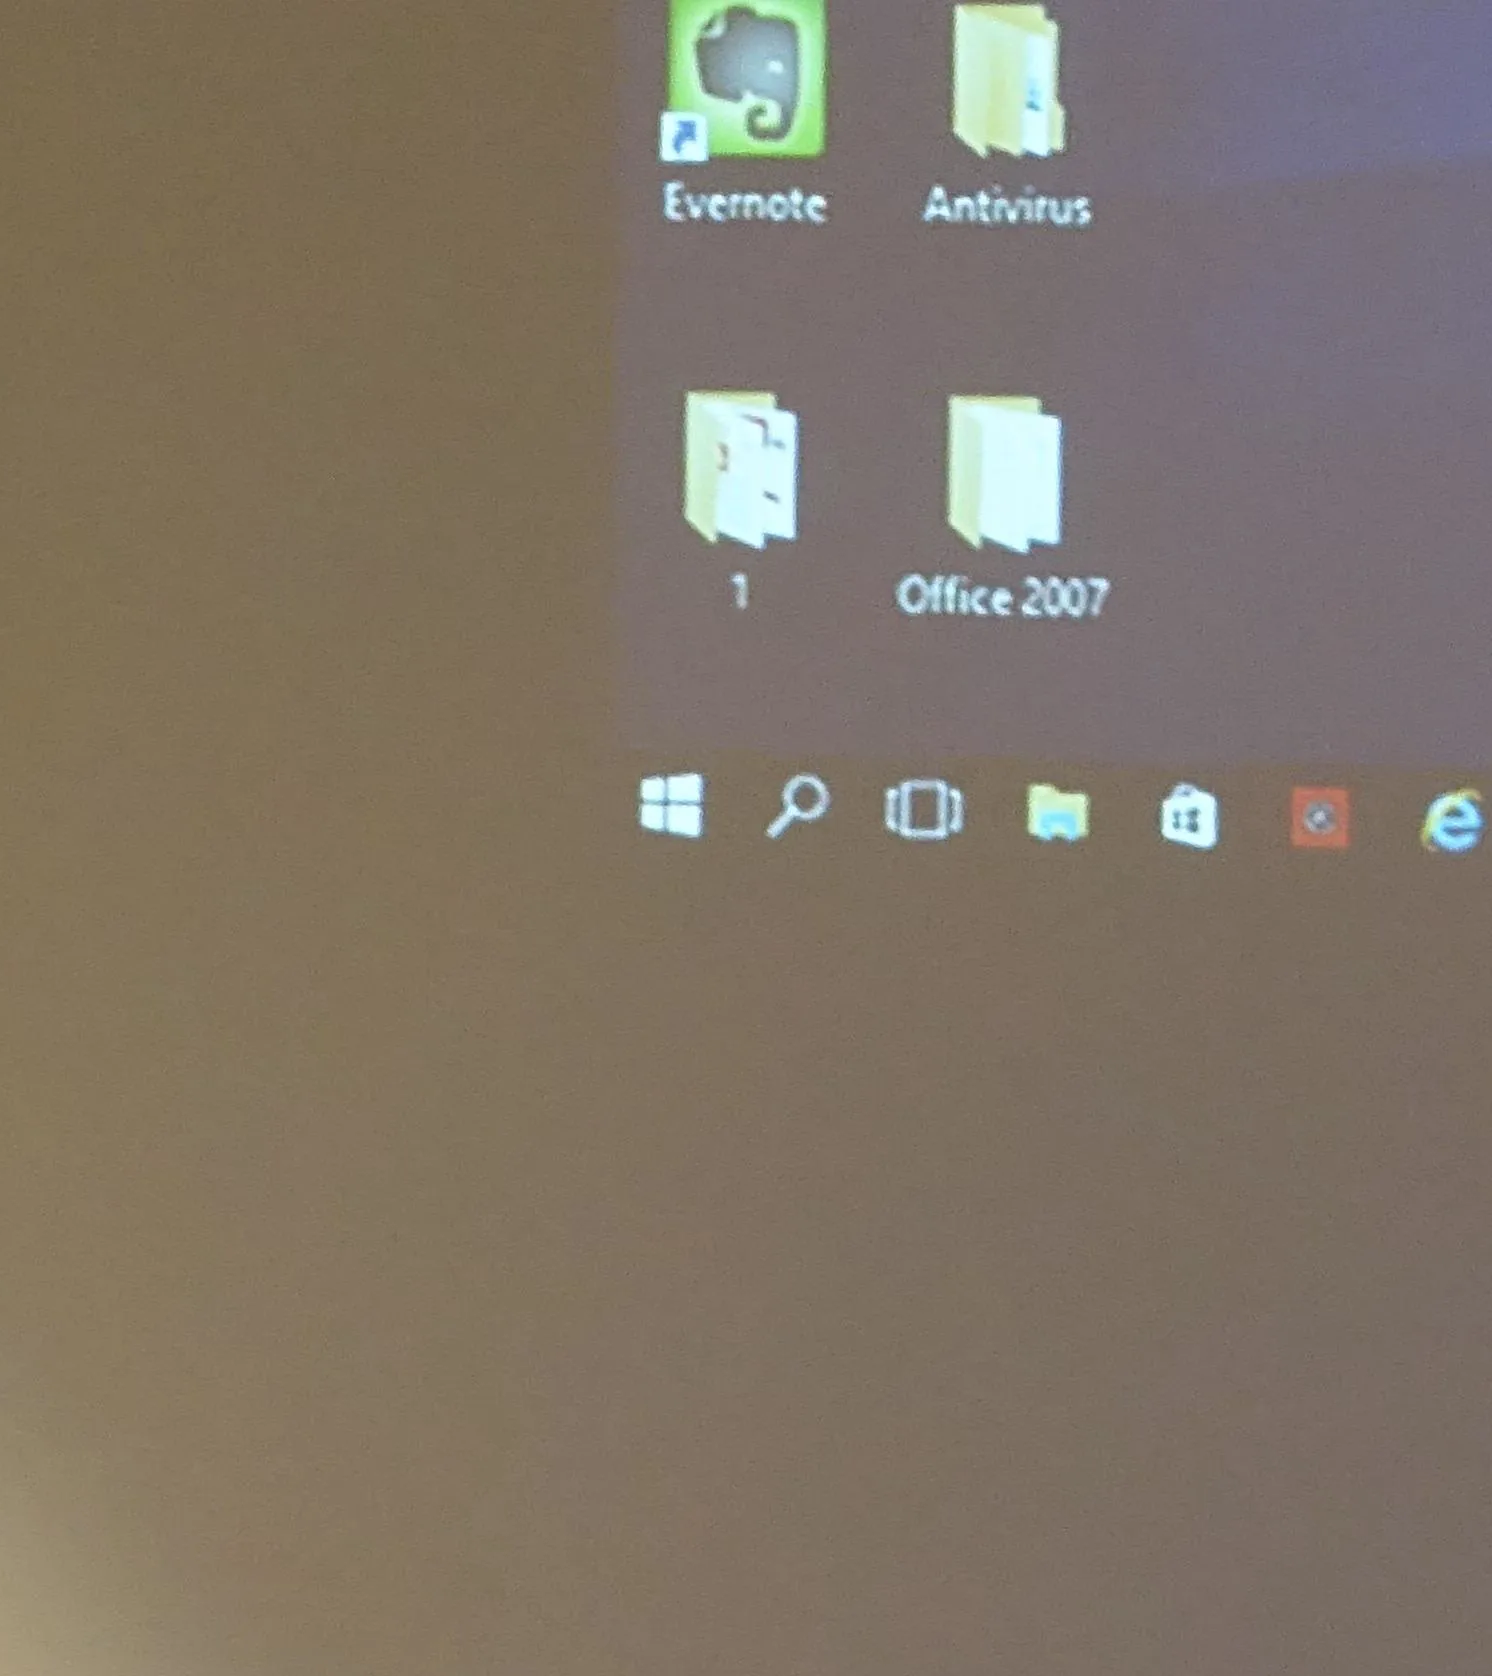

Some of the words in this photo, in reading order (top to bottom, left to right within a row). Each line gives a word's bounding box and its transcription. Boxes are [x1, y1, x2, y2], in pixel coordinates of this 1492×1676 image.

[661, 179, 828, 223] Evernote
[922, 183, 1093, 228] Antivirus
[895, 571, 1014, 616] Office
[1020, 575, 1112, 618] 2007
